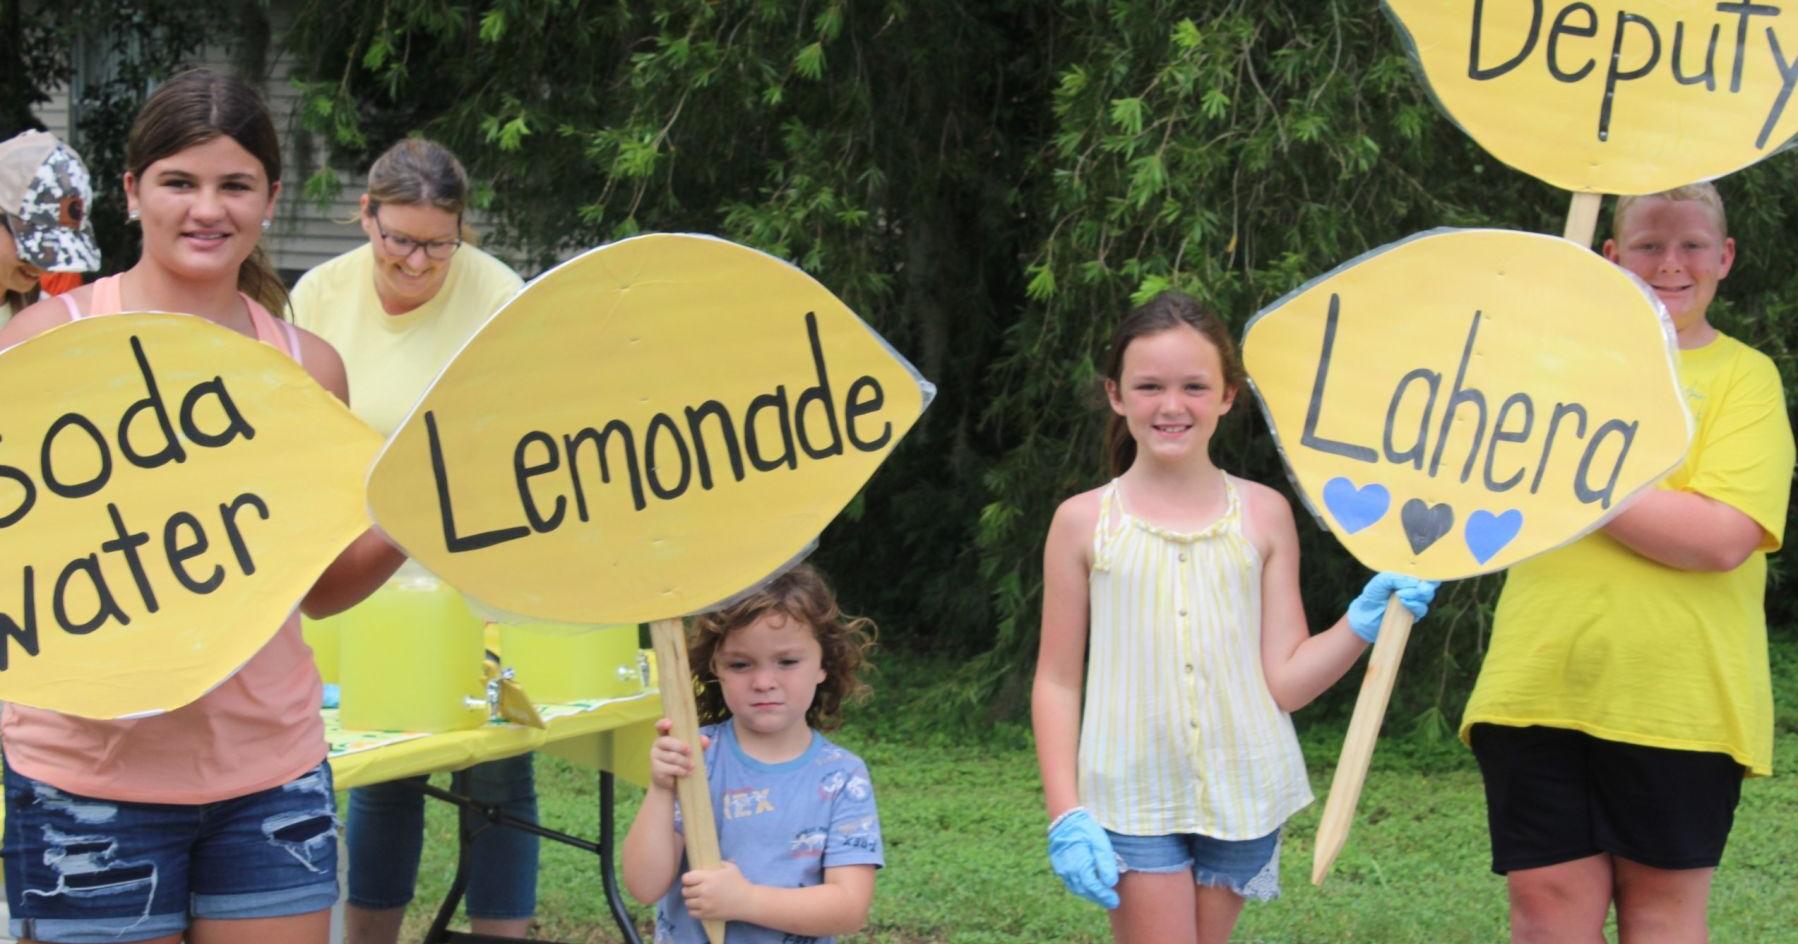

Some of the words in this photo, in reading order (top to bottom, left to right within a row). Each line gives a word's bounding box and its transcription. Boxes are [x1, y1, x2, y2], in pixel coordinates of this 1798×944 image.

[1468, 0, 1798, 149] Deputy
[424, 311, 892, 553] Lemonade
[1300, 293, 1638, 509] Lahera
